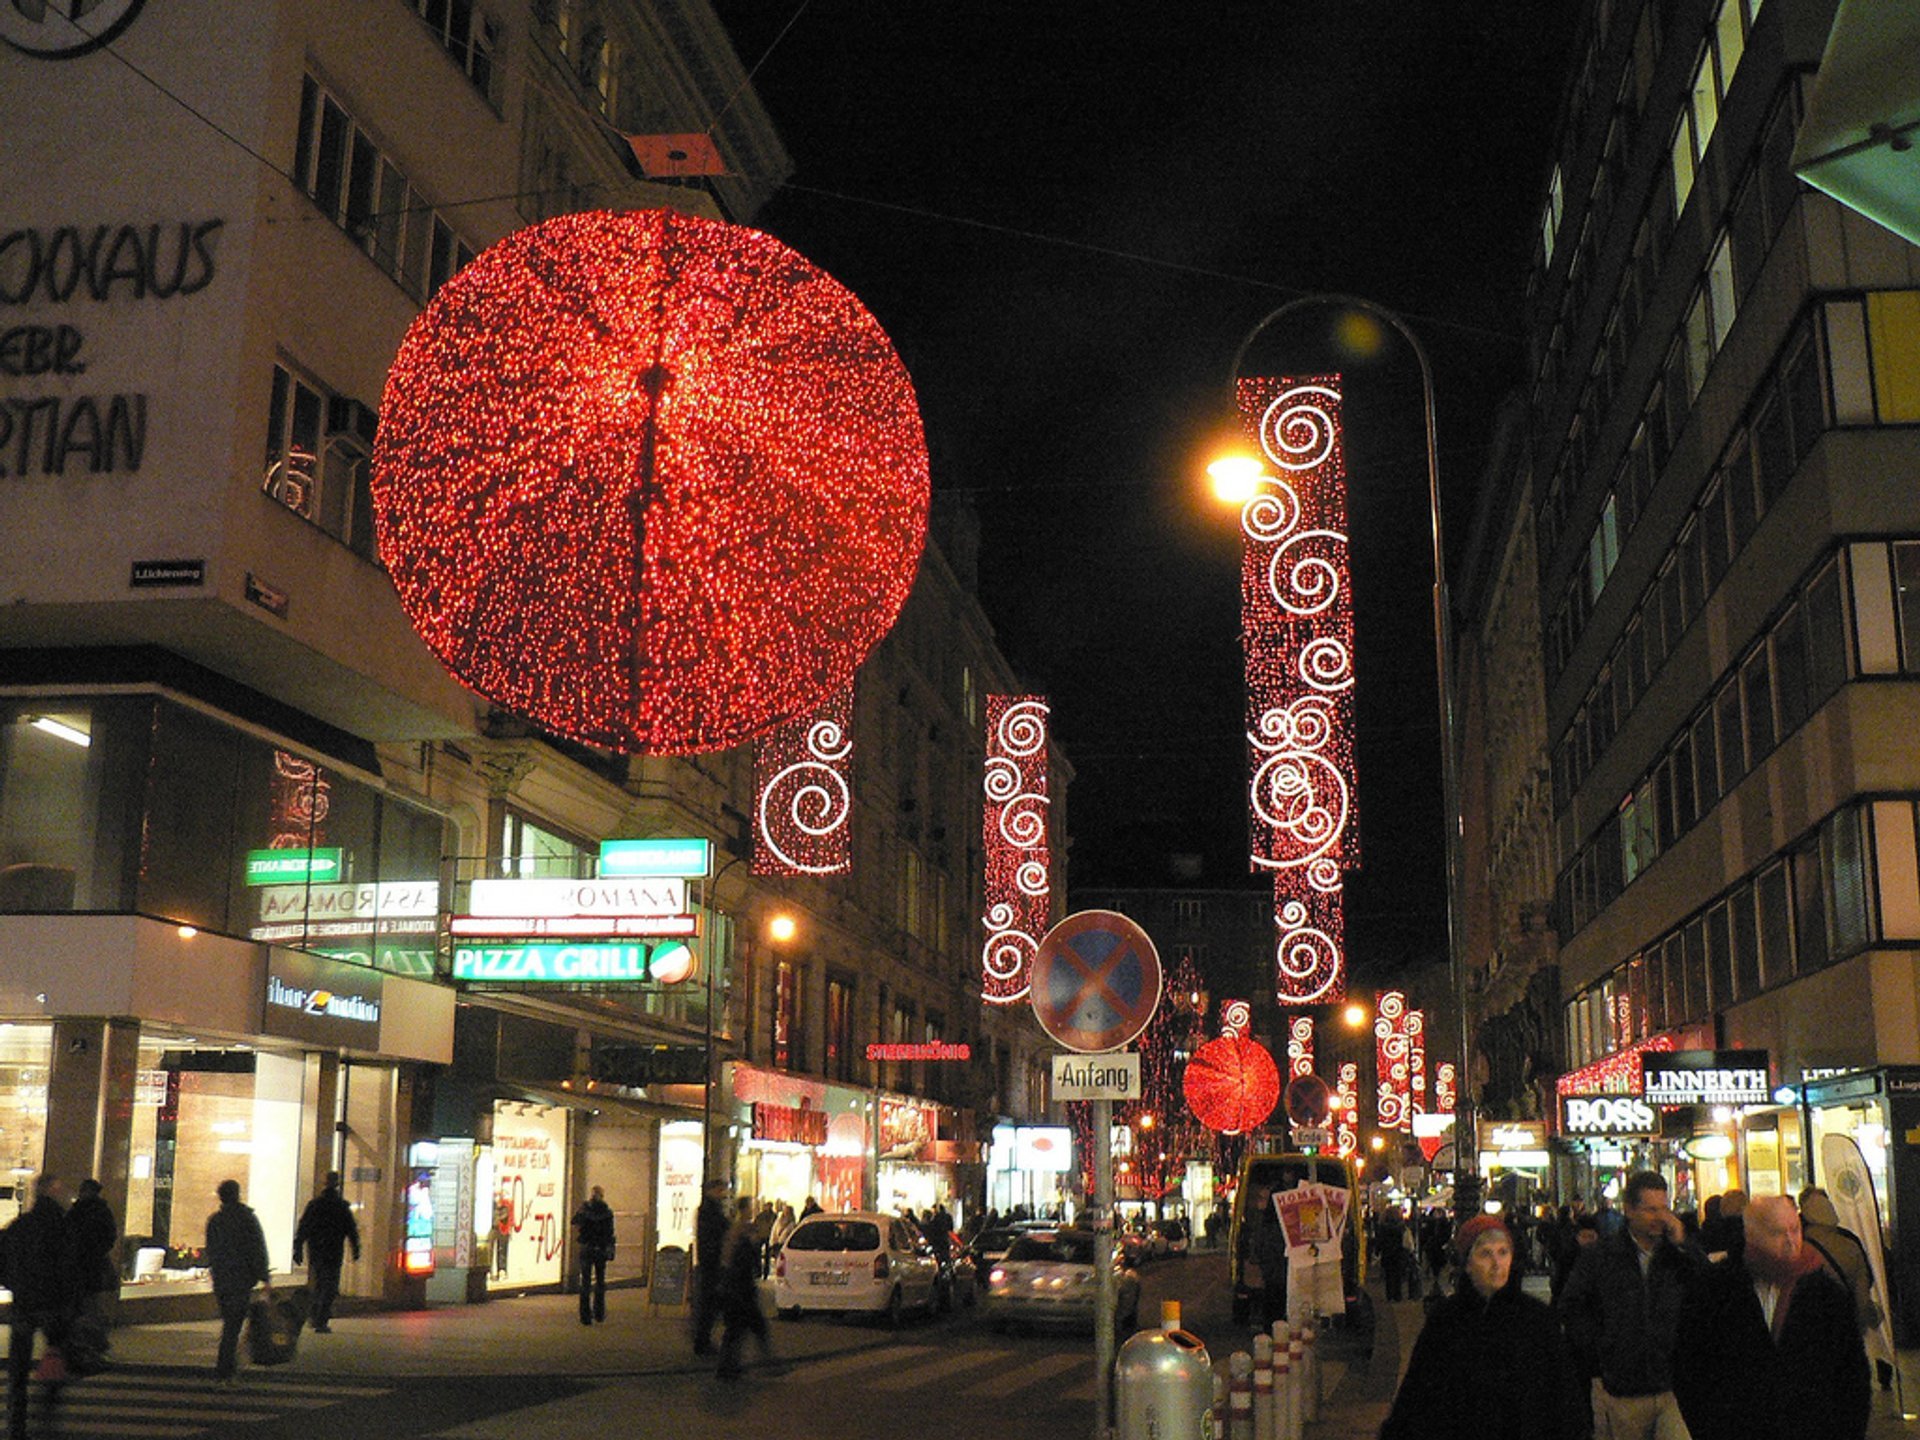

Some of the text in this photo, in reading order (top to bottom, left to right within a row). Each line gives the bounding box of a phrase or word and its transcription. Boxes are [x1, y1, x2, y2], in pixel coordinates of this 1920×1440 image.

[454, 948, 645, 978] PIZZA GRILL
[1061, 1061, 1129, 1092] Anfang
[1645, 1069, 1768, 1091] LINNERTH
[1566, 1098, 1655, 1128] BOSS
